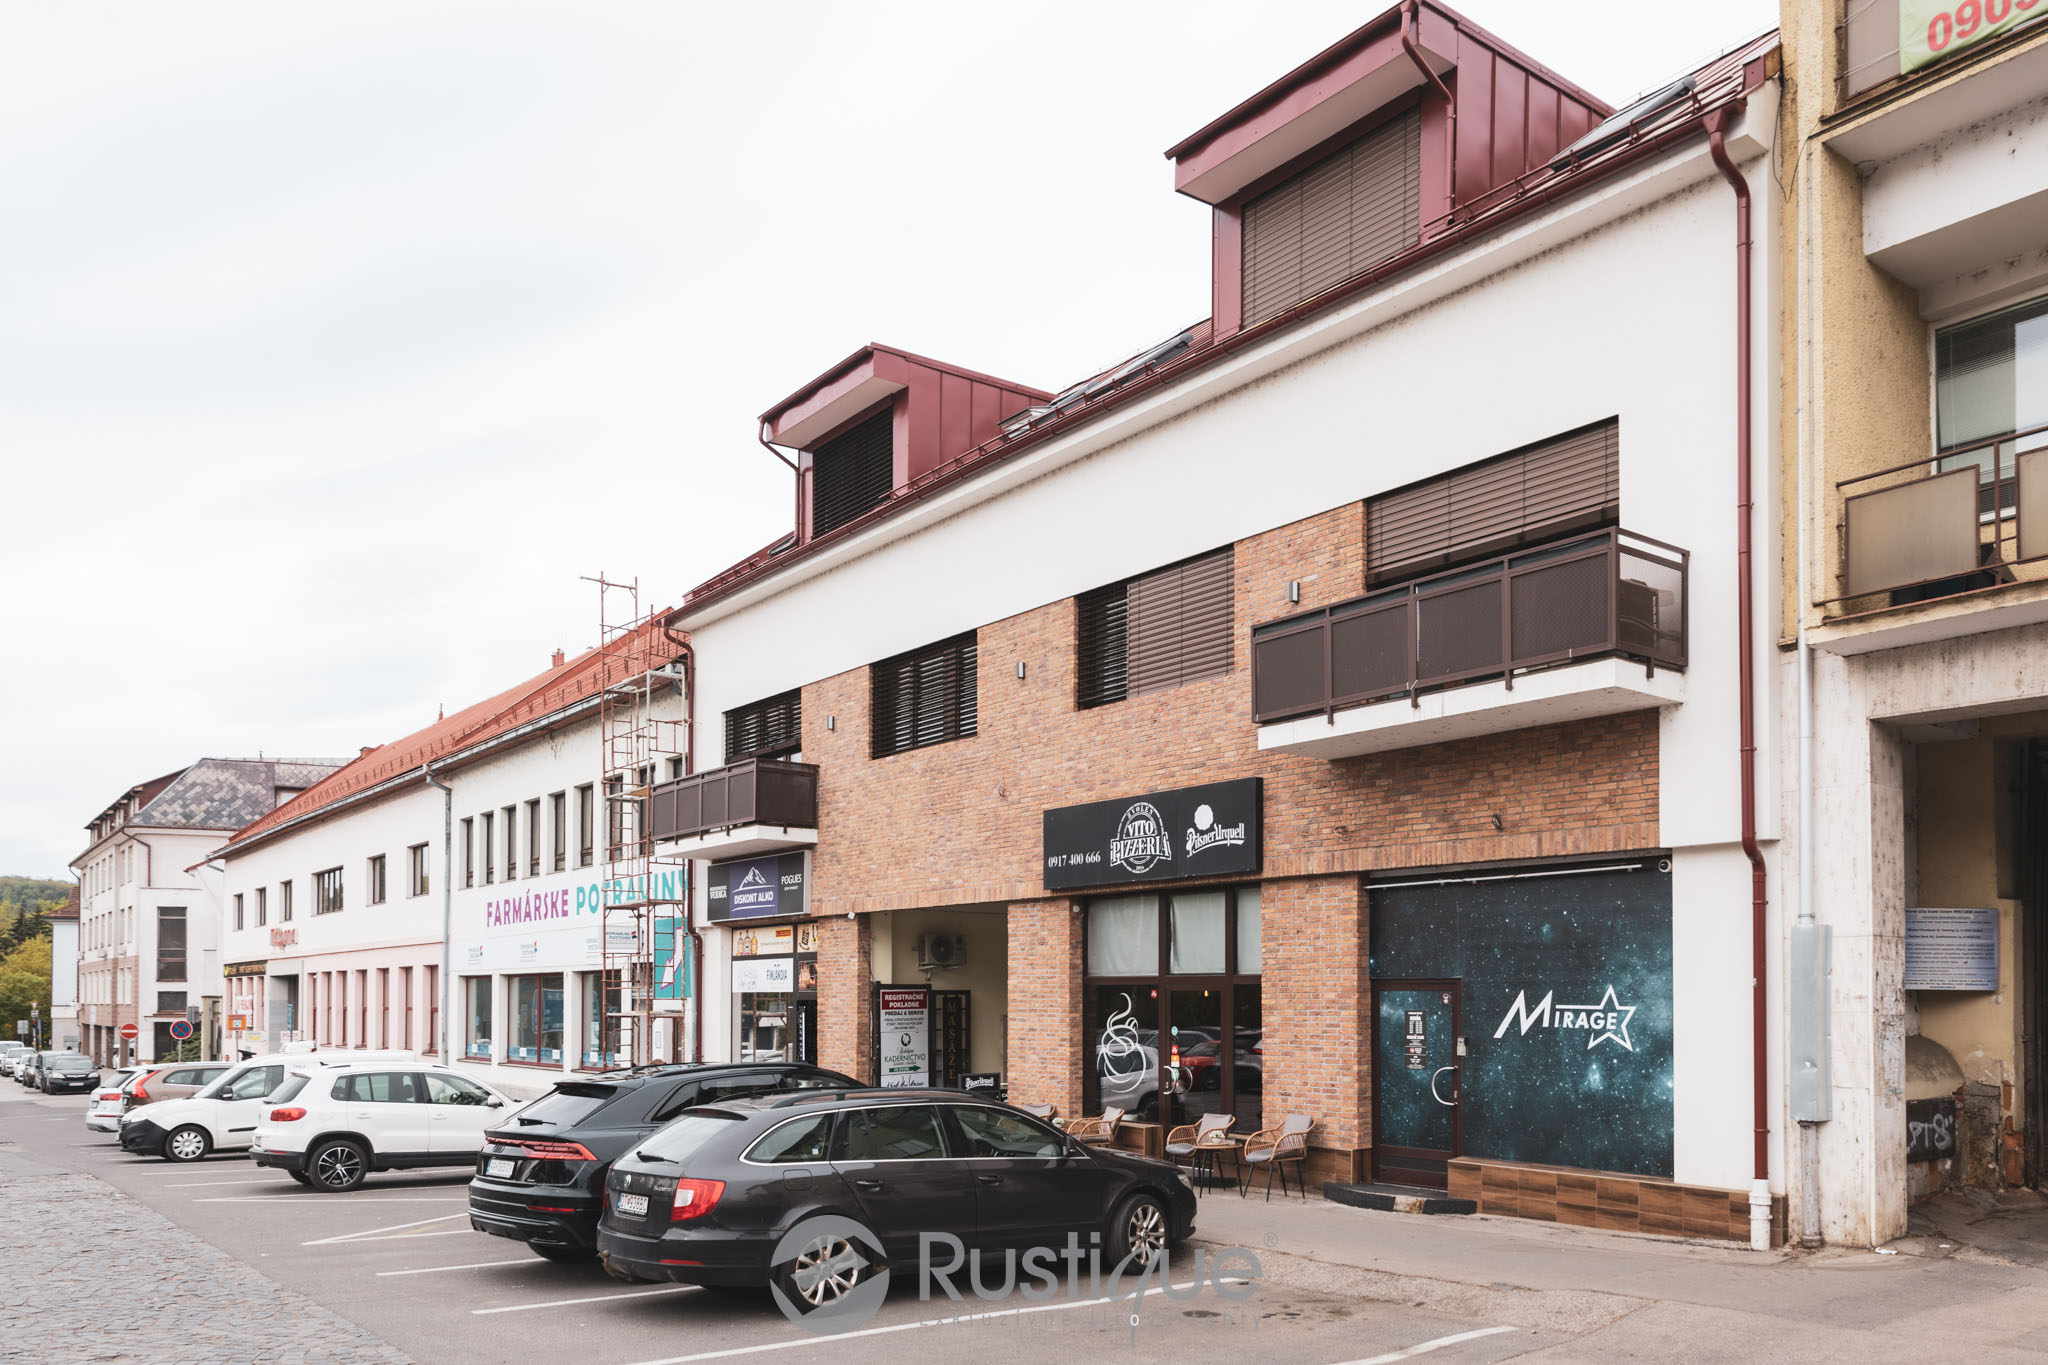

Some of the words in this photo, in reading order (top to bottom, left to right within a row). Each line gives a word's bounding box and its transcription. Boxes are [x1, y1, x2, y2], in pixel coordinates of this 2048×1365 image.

[1927, 0, 2041, 52] 090
[1128, 820, 1154, 837] VITO
[1112, 833, 1170, 863] PIZZERIA
[1048, 855, 1067, 868] 0917
[1068, 853, 1084, 866] 400
[1085, 851, 1101, 864] 666
[781, 873, 802, 885] POGUES
[734, 892, 757, 905] DISKONT
[757, 890, 774, 903] ALKO
[486, 888, 569, 928] FARMÁRSKE
